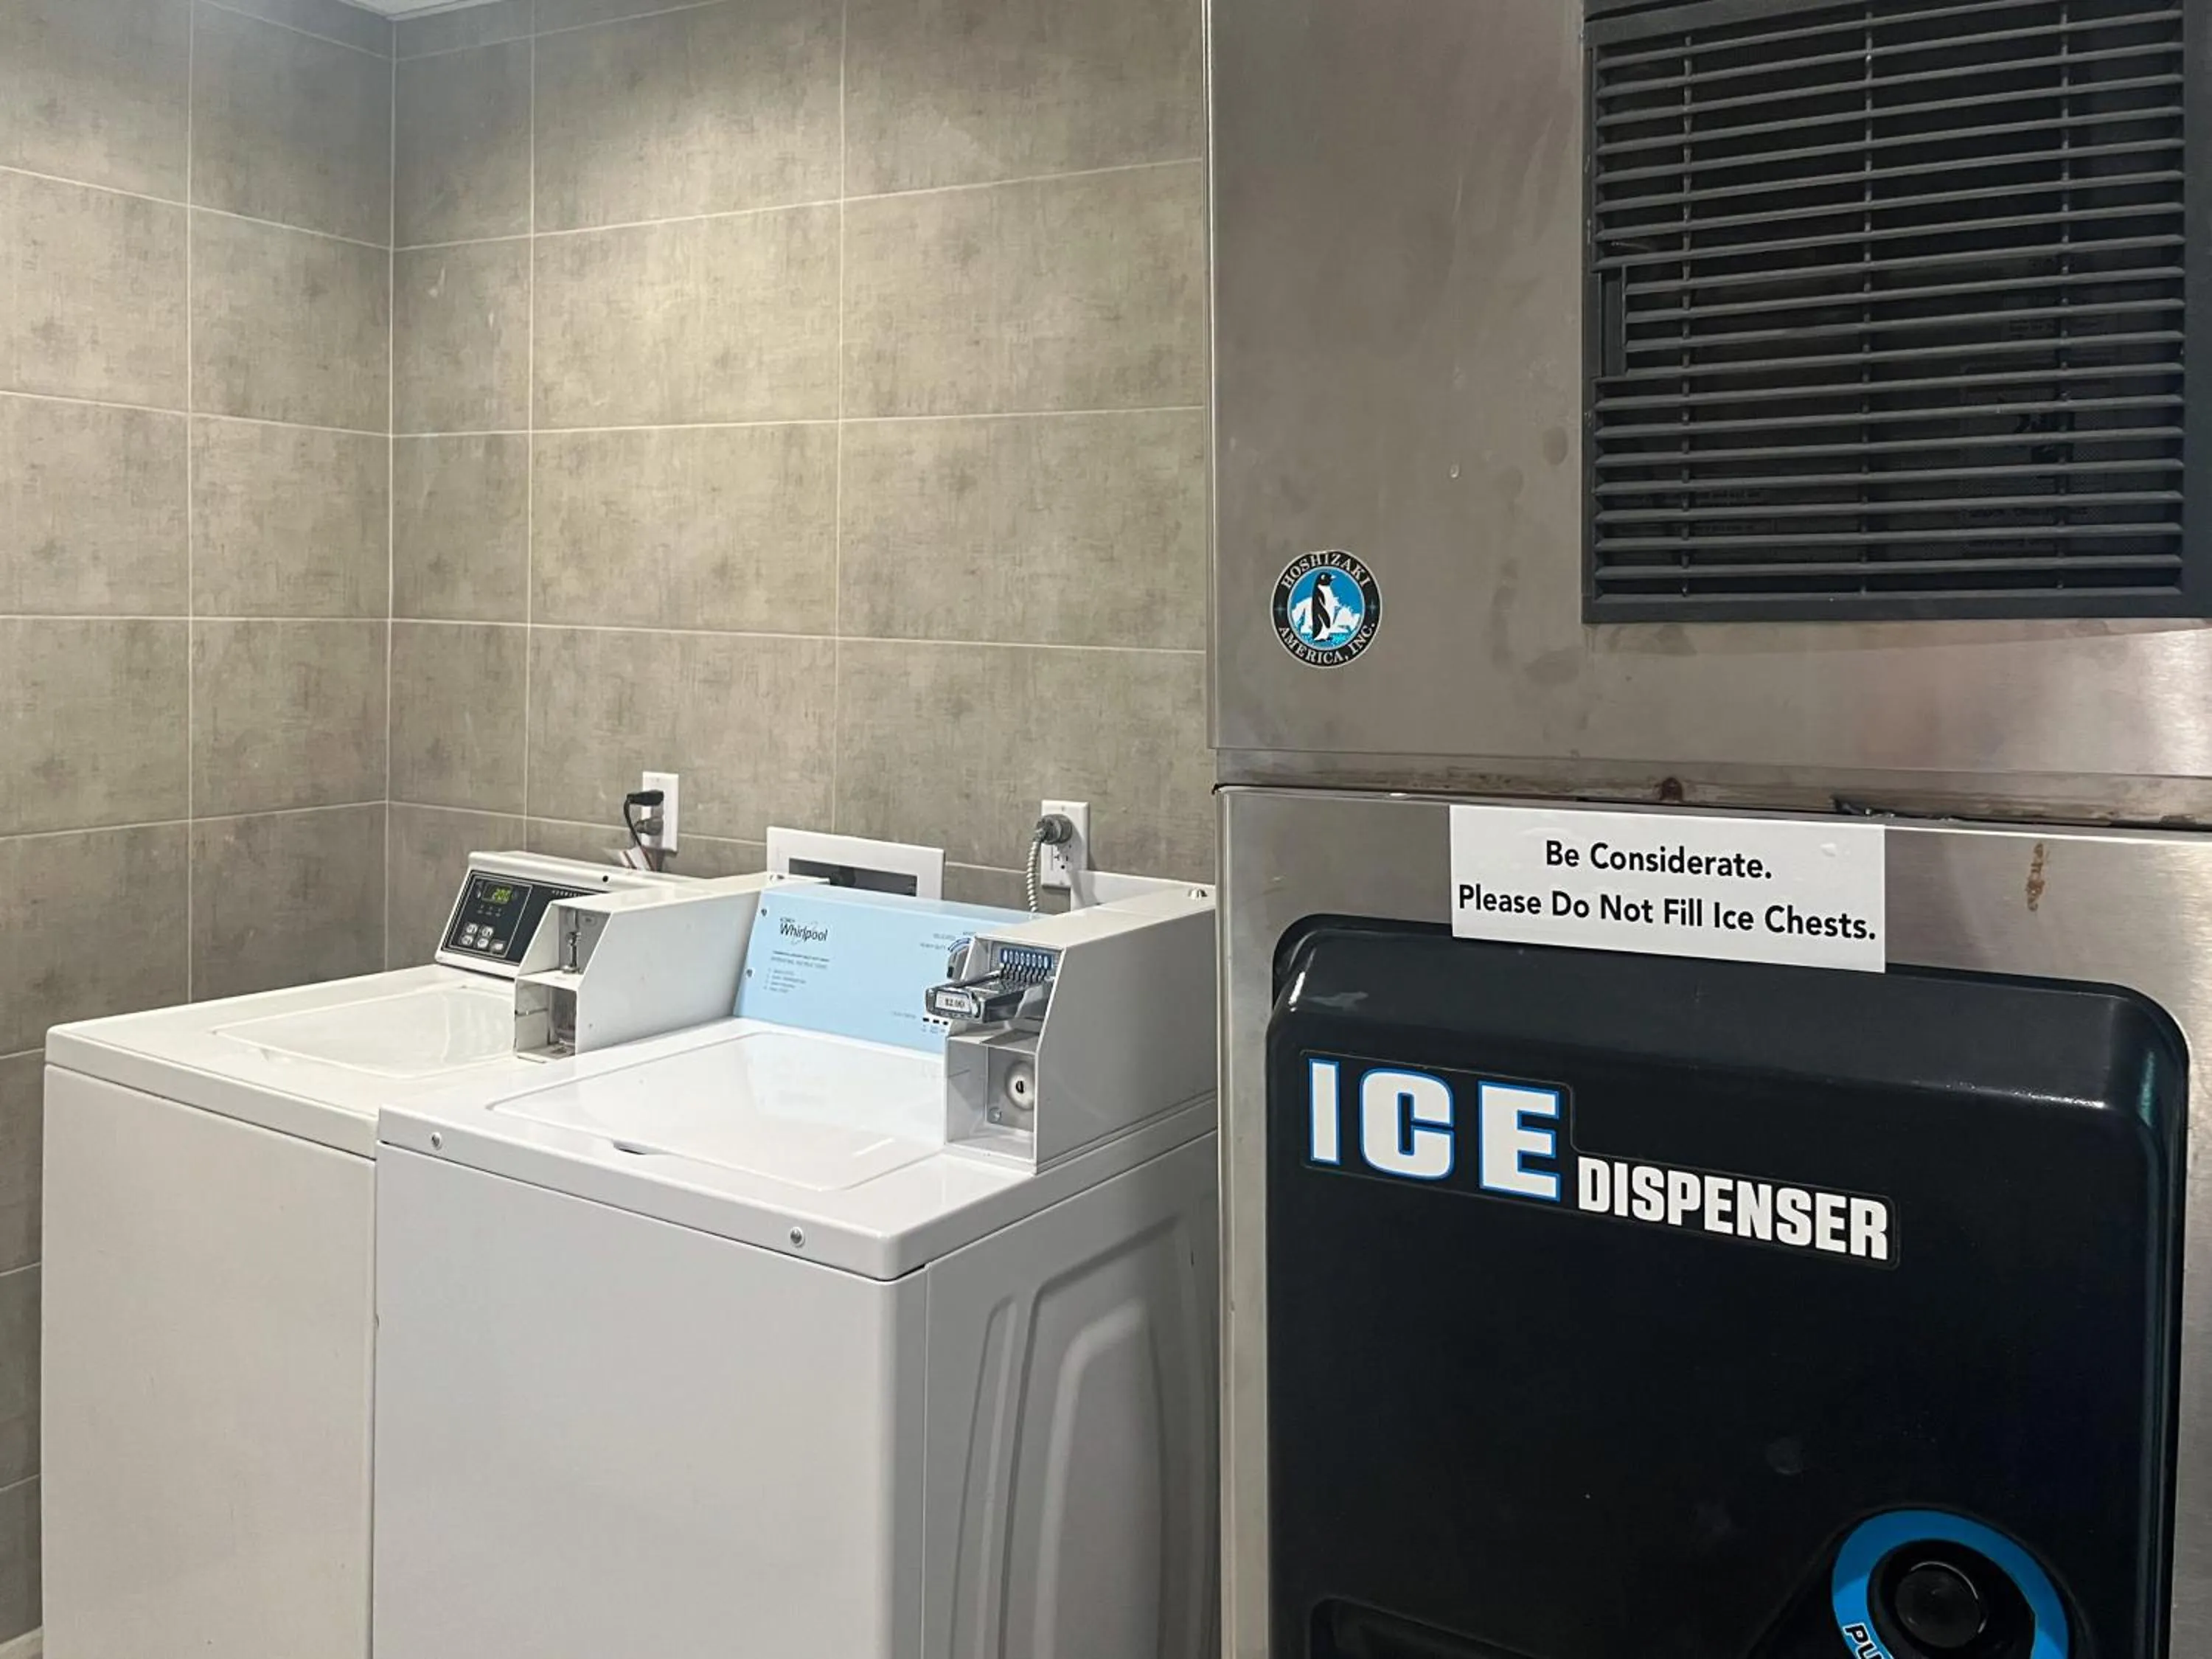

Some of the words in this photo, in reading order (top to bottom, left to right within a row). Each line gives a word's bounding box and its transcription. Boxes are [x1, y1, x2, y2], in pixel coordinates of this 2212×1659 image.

[1281, 553, 1371, 589] HOSHIZAKI
[1279, 627, 1349, 664] AMERICA,
[1348, 622, 1376, 655] INC.
[1546, 840, 1580, 868] Be
[1590, 842, 1773, 880] Considerate.
[1459, 883, 1542, 915] Please
[1552, 890, 1590, 918] Do
[1600, 894, 1654, 924] Not
[1664, 897, 1703, 927] Fill
[1714, 902, 1754, 931] Ice
[1764, 904, 1876, 940] Chests.
[780, 923, 827, 942] Whirlpool
[1308, 1057, 1560, 1202] ICE
[1577, 1155, 1888, 1260] DISPENSER
